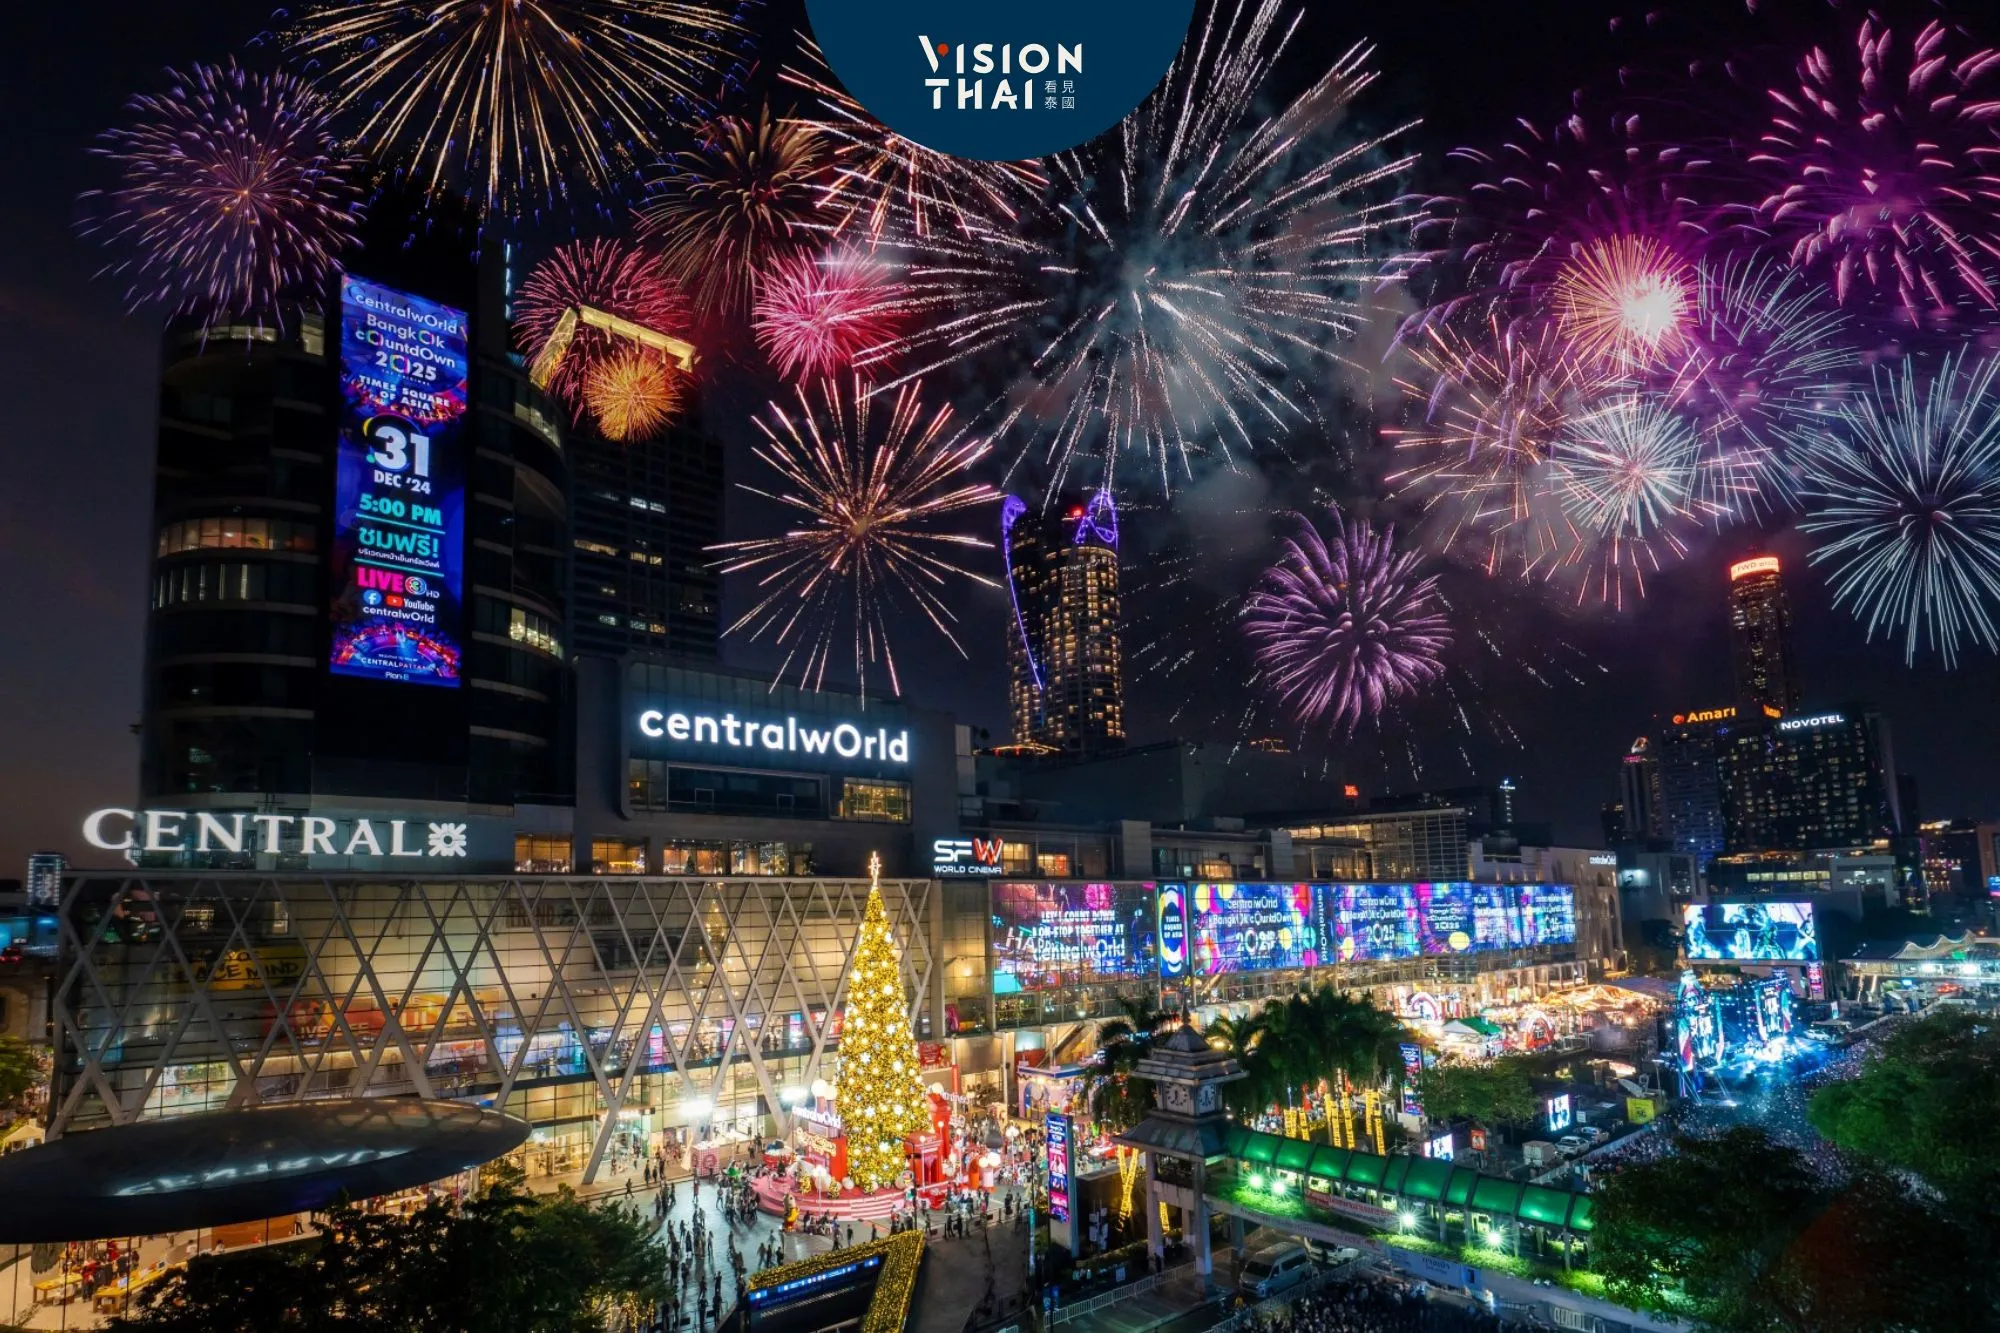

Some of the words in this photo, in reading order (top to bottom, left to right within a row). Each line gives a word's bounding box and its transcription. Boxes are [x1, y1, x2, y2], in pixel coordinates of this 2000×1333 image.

[366, 313, 445, 349] BangkOk
[375, 350, 437, 381] 2025
[358, 375, 397, 392] TIMES
[402, 388, 450, 407] SQUARE
[380, 391, 396, 401] OF
[401, 397, 431, 411] ASIA
[374, 426, 430, 477] 31
[374, 470, 402, 487] DEC
[359, 493, 405, 518] 5:00
[411, 504, 443, 526] PM
[358, 526, 440, 559] ชมฟรี!
[357, 566, 404, 593] LIVE
[426, 590, 440, 599] HD
[362, 605, 435, 623] centralwOrld
[403, 599, 435, 612] YouTube
[1687, 707, 1736, 723] Amari
[1780, 714, 1845, 730] NOVOTEL
[639, 709, 910, 764] centralwOrld
[82, 807, 423, 867] CENTRAL
[933, 865, 966, 874] WORLD
[967, 865, 1002, 875] CINEMA
[1064, 910, 1090, 922] COUNT
[1114, 924, 1125, 936] AT
